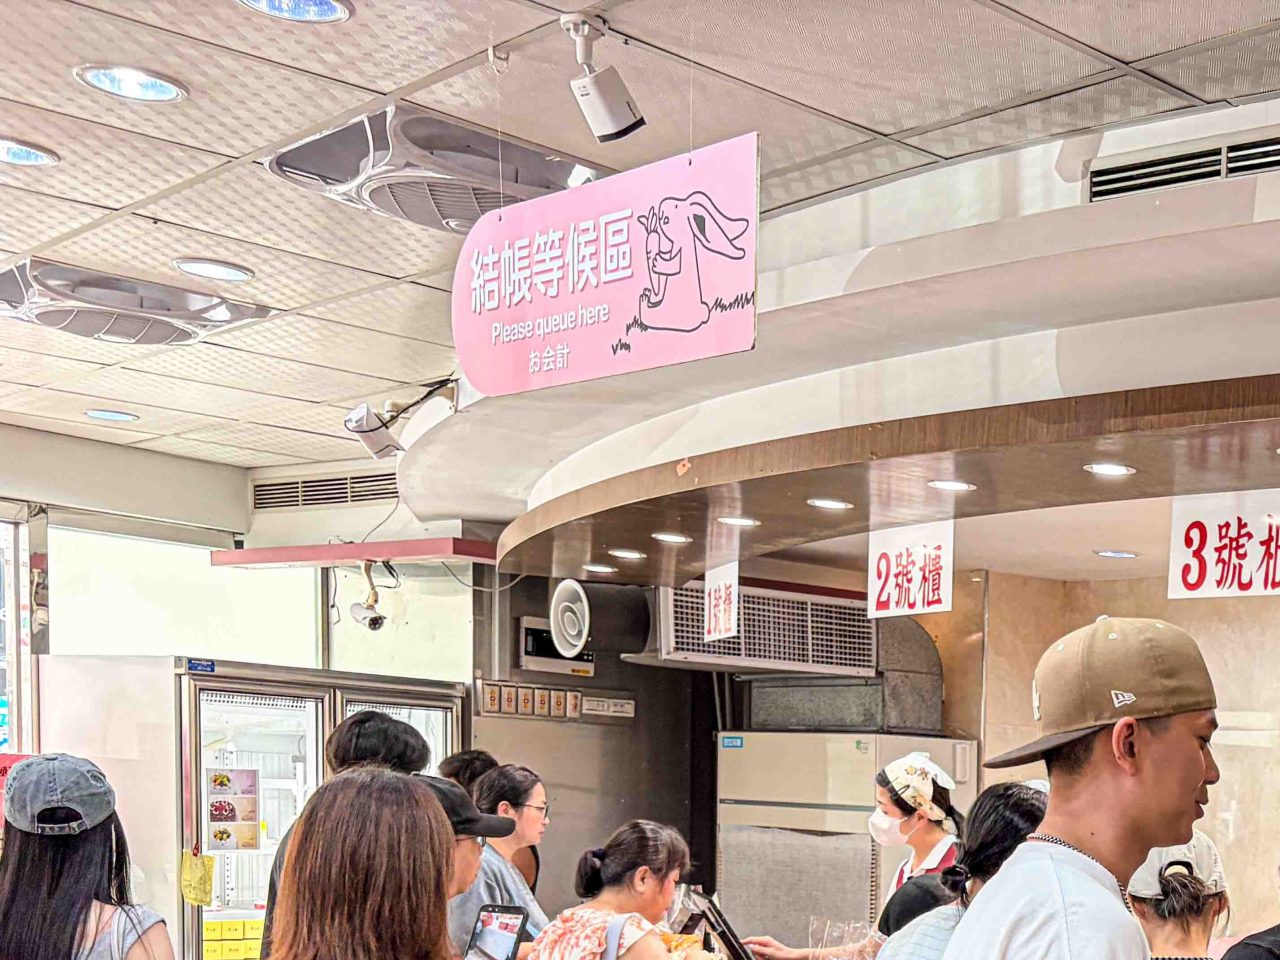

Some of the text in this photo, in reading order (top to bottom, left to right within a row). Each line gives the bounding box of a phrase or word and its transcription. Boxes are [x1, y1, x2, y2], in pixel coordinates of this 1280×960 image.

[470, 207, 634, 314] 結帳等候區
[491, 302, 609, 345] Please queue here
[529, 344, 570, 373] お会計
[875, 544, 943, 611] 2號櫃
